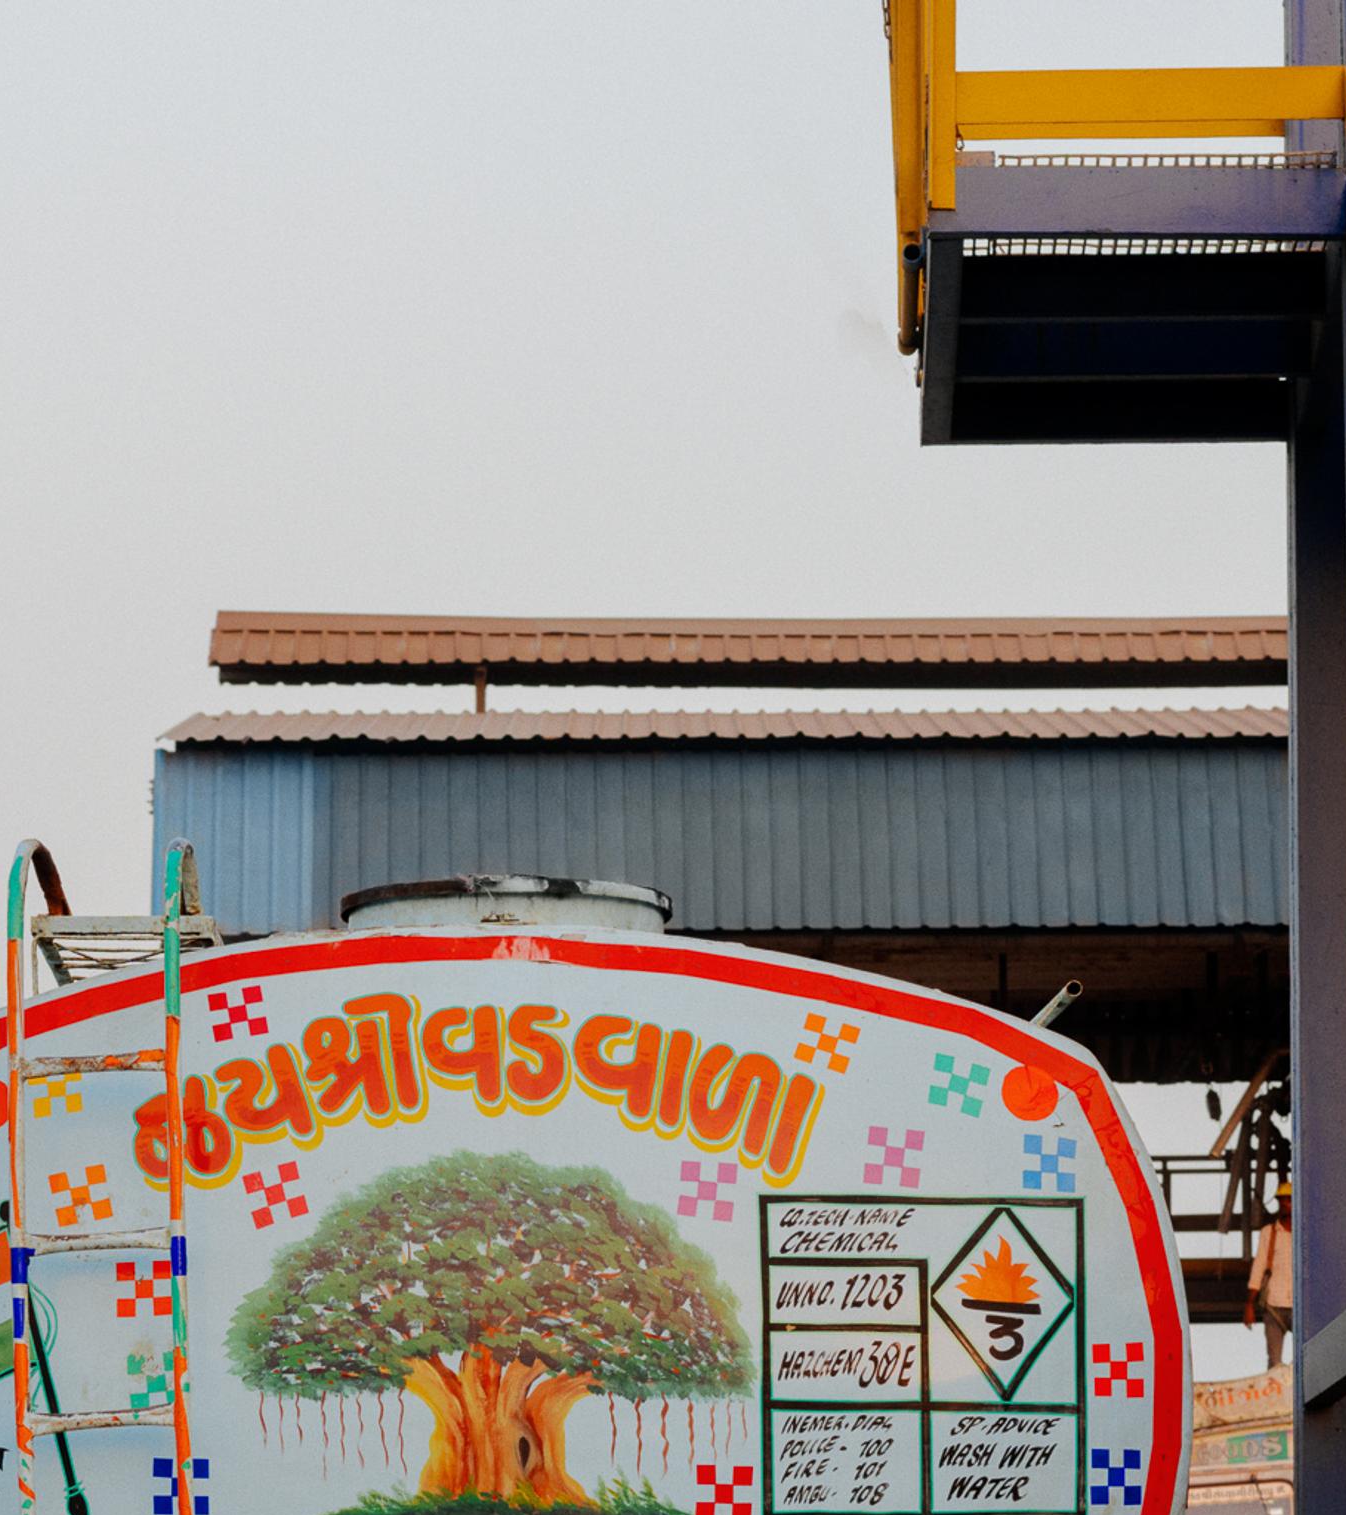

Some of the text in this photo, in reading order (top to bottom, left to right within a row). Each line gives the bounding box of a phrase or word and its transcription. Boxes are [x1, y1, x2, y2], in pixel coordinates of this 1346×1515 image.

[780, 1231, 898, 1254] CHEMICAL
[841, 1273, 906, 1310] 1203
[985, 1315, 1025, 1361] 3
[860, 1438, 894, 1458] 100
[939, 1443, 1057, 1469] WASH WITH
[855, 1460, 888, 1480] 101
[849, 1482, 890, 1506] 108
[947, 1475, 1029, 1502] WATER
